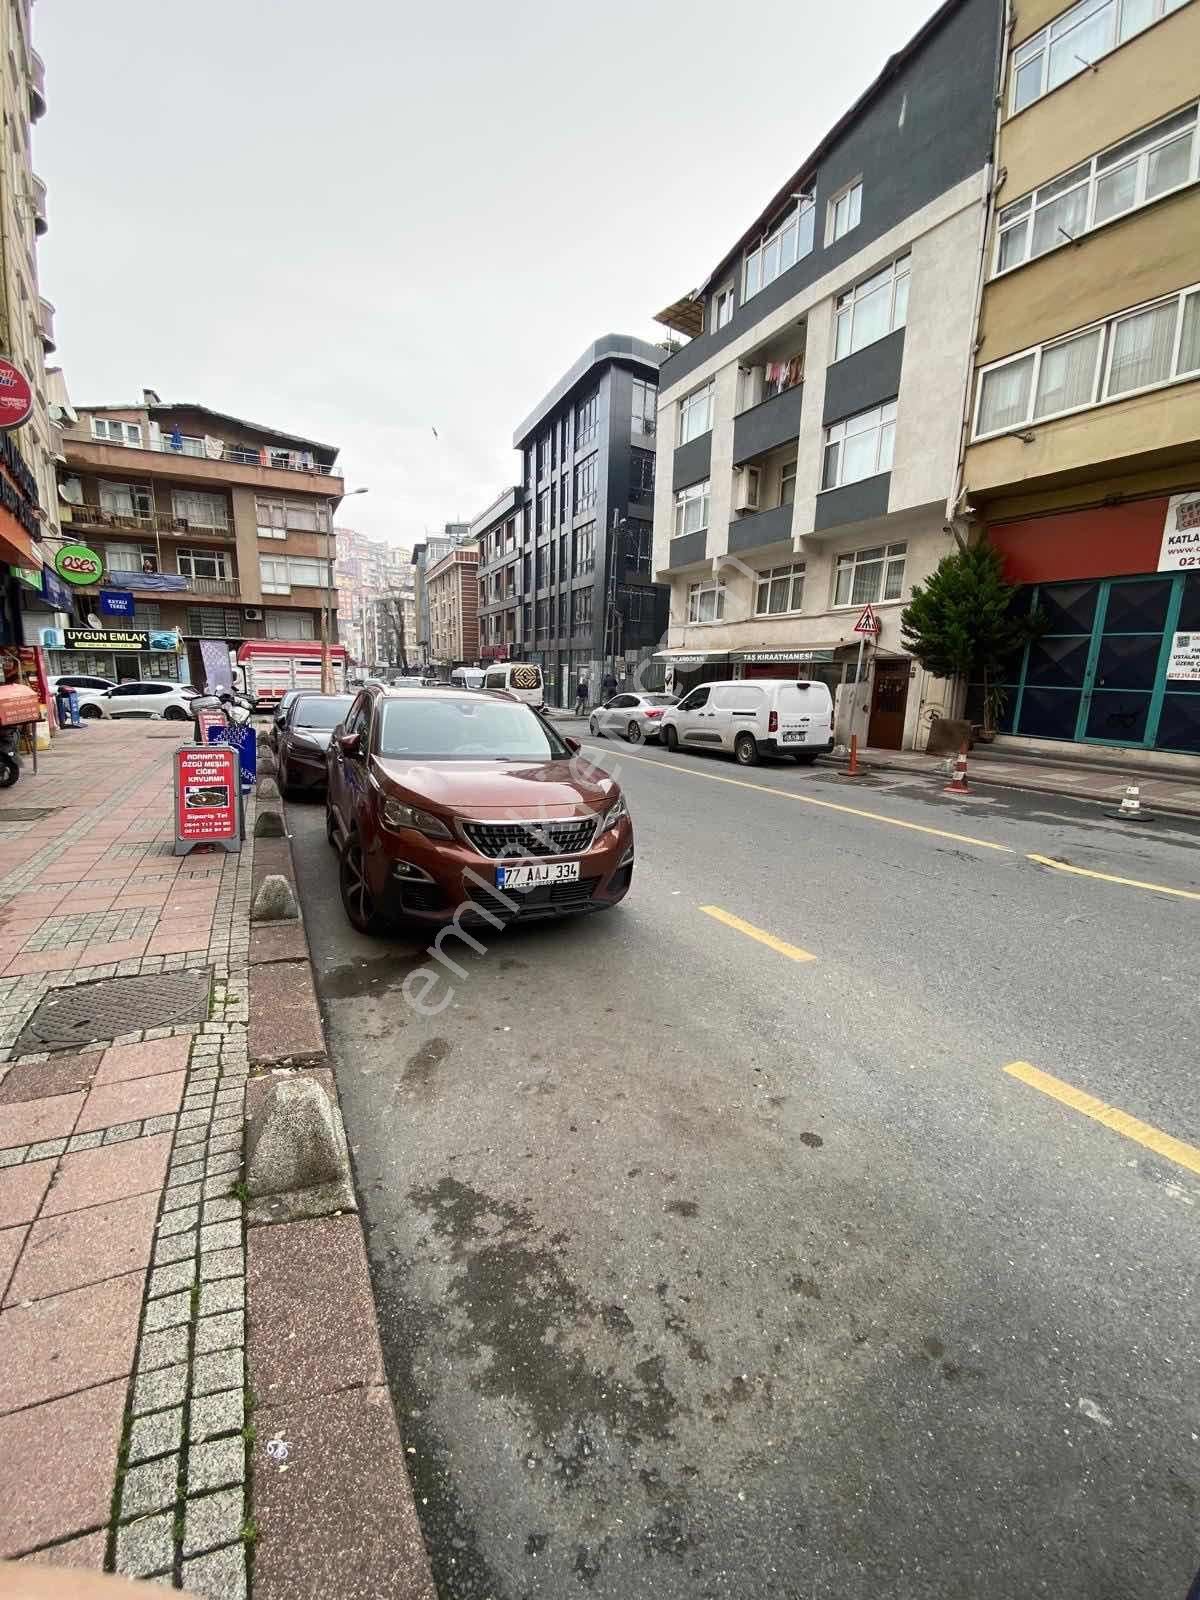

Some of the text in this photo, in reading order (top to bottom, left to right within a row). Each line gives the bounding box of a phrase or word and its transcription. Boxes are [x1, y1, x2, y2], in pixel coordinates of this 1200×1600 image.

[67, 631, 147, 642] UYGUN EMLAK
[758, 652, 814, 661] KIRAATHANESİ
[505, 869, 521, 883] 77
[526, 867, 549, 881] AAJ
[556, 864, 577, 878] 334
